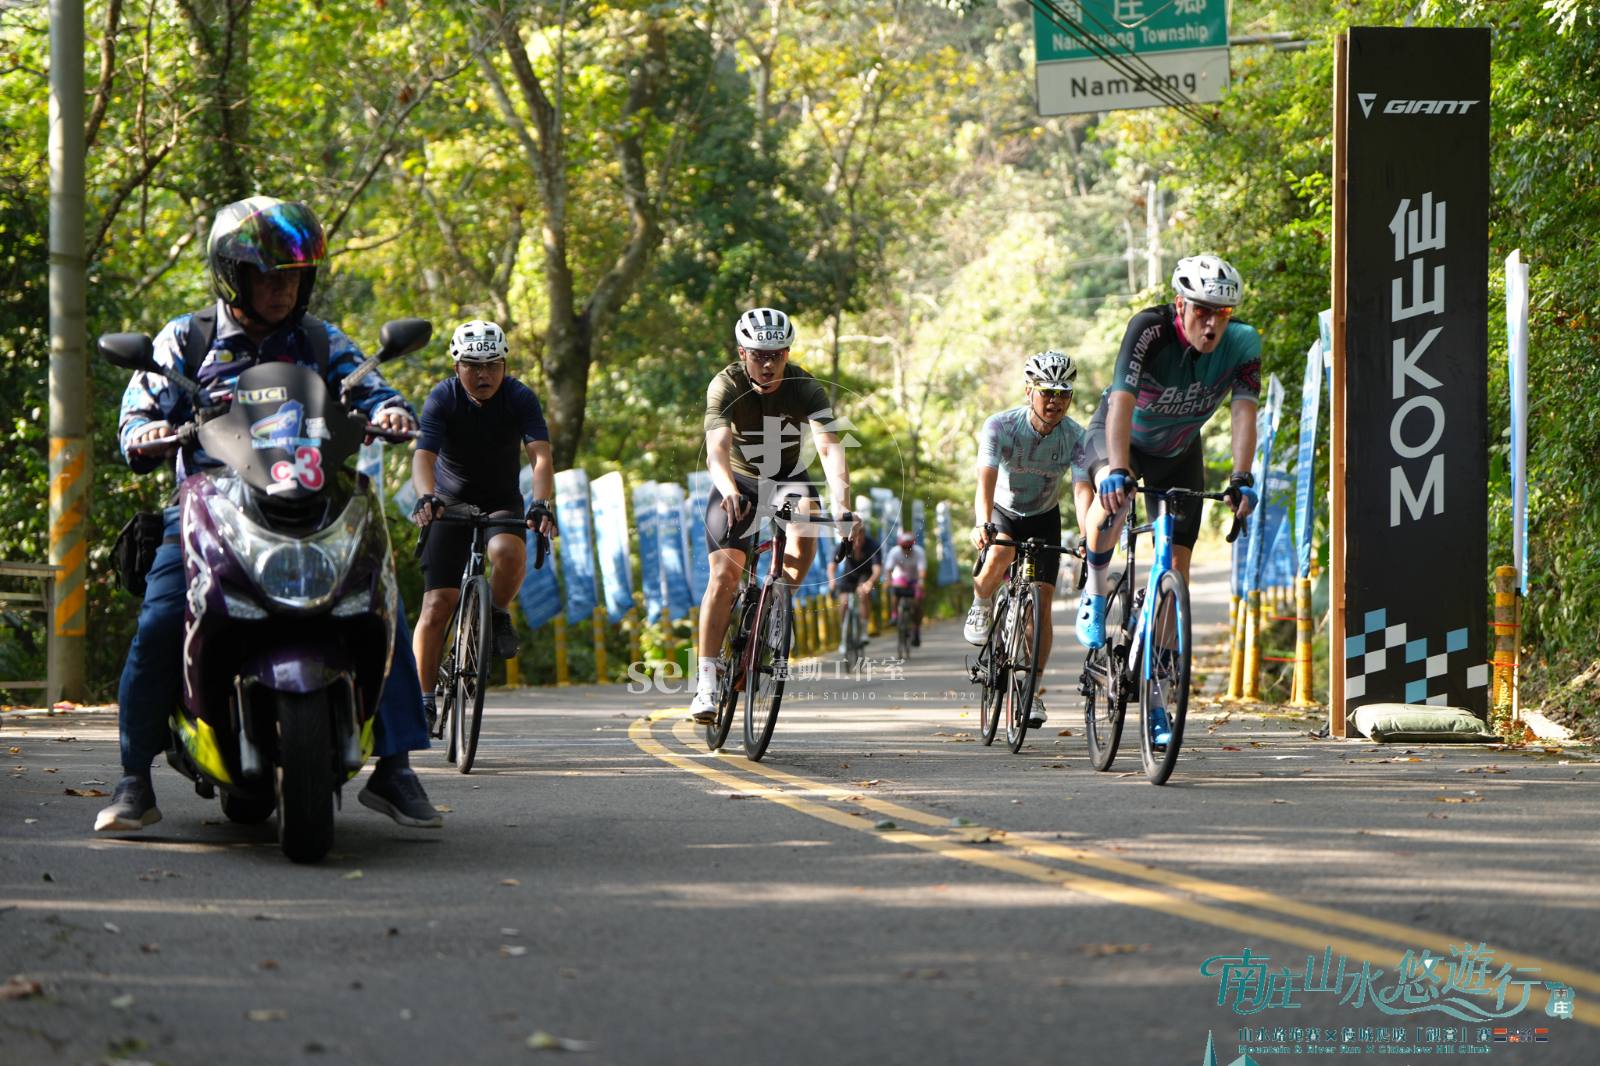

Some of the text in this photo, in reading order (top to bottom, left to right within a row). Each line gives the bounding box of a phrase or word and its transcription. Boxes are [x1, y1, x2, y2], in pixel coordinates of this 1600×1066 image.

[1140, 25, 1208, 44] Township
[1070, 73, 1196, 98] Namzong
[1383, 99, 1480, 115] GIANT
[1145, 393, 1216, 415] KNIGHT
